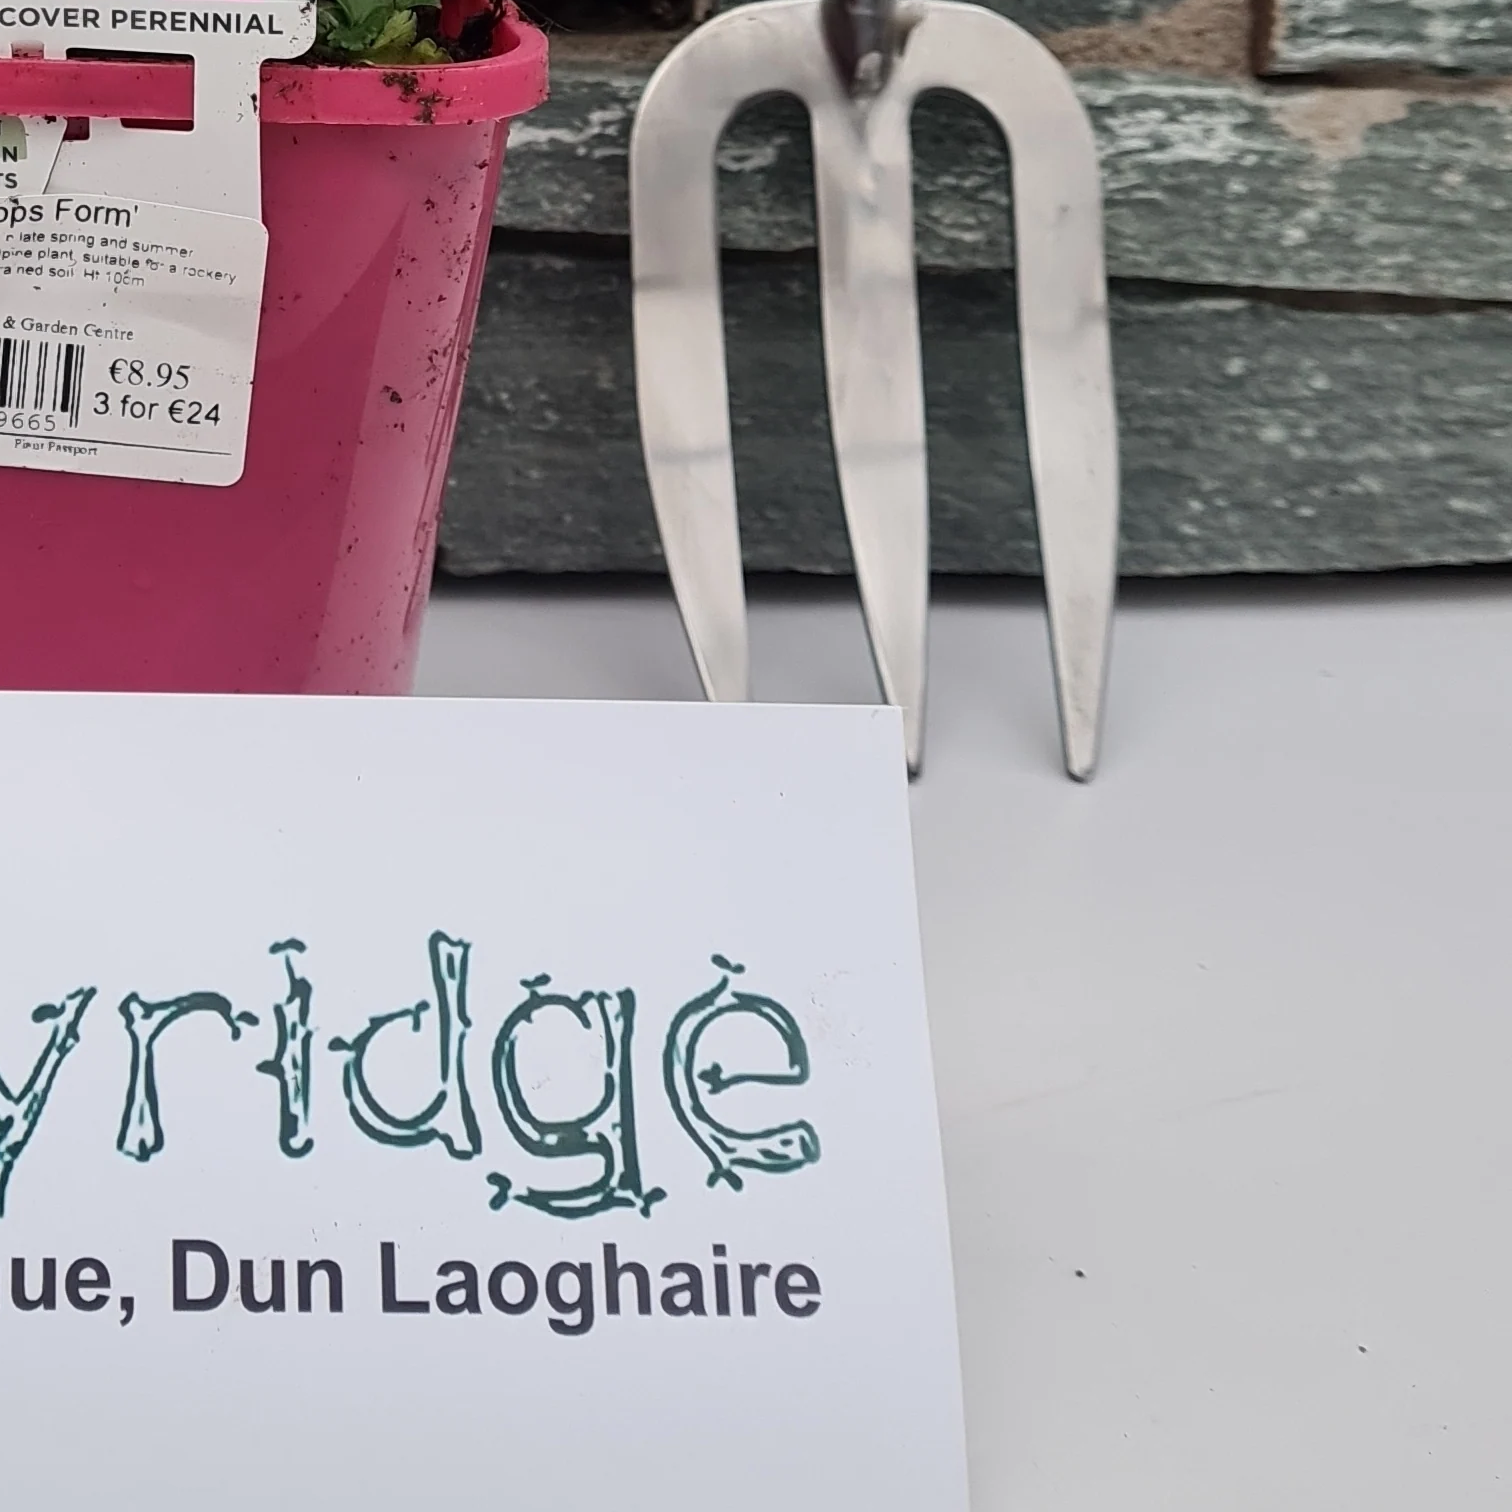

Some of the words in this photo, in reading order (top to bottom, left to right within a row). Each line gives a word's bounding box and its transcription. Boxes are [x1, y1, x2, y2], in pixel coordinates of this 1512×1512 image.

[111, 9, 284, 36] PERENNIAL
[55, 198, 139, 228] Form'
[19, 232, 46, 243] late
[50, 232, 95, 248] spring
[100, 237, 127, 249] and
[132, 241, 194, 258] summer
[82, 253, 140, 269] suitable
[169, 264, 177, 274] a
[182, 266, 237, 285] rockery
[3, 315, 17, 330] &
[21, 317, 79, 336] Garden
[83, 323, 135, 341] Centre
[108, 358, 192, 390] €8.95
[93, 391, 111, 416] 3
[120, 394, 160, 420] for
[168, 399, 222, 426] €24
[168, 1240, 345, 1318] Dun
[378, 1240, 824, 1336] Laoghaire
